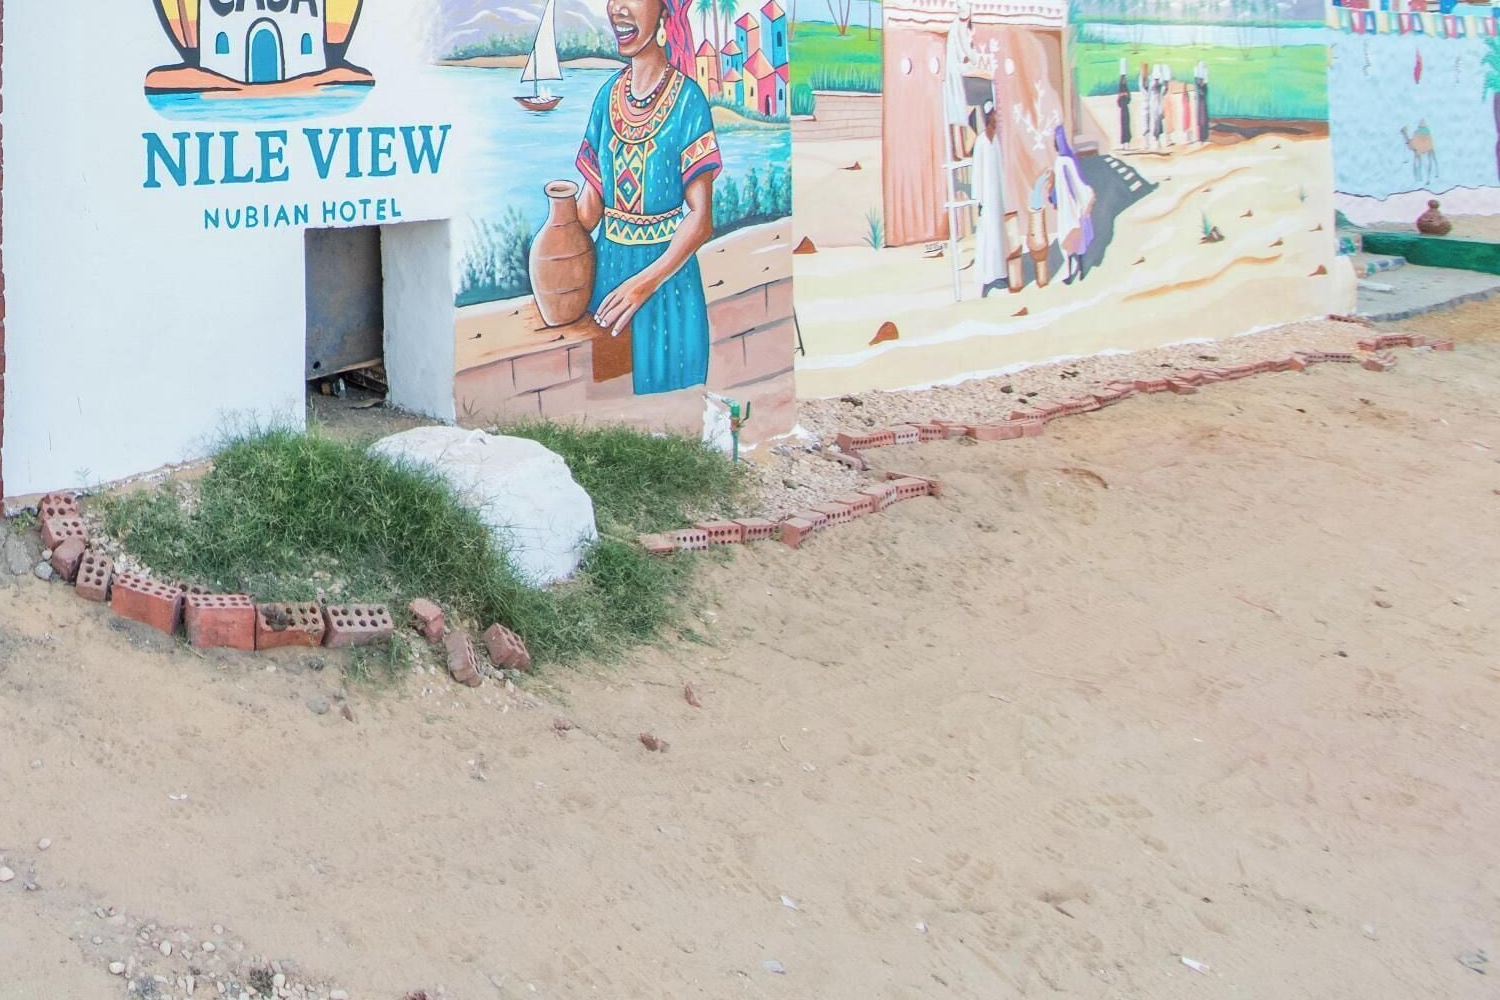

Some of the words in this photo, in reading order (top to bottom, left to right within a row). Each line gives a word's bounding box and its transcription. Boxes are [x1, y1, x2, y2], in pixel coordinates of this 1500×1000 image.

[142, 130, 290, 188] NILE
[302, 124, 452, 179] VIEW
[204, 203, 309, 229] NUBIAN
[322, 198, 402, 226] HOTEL
